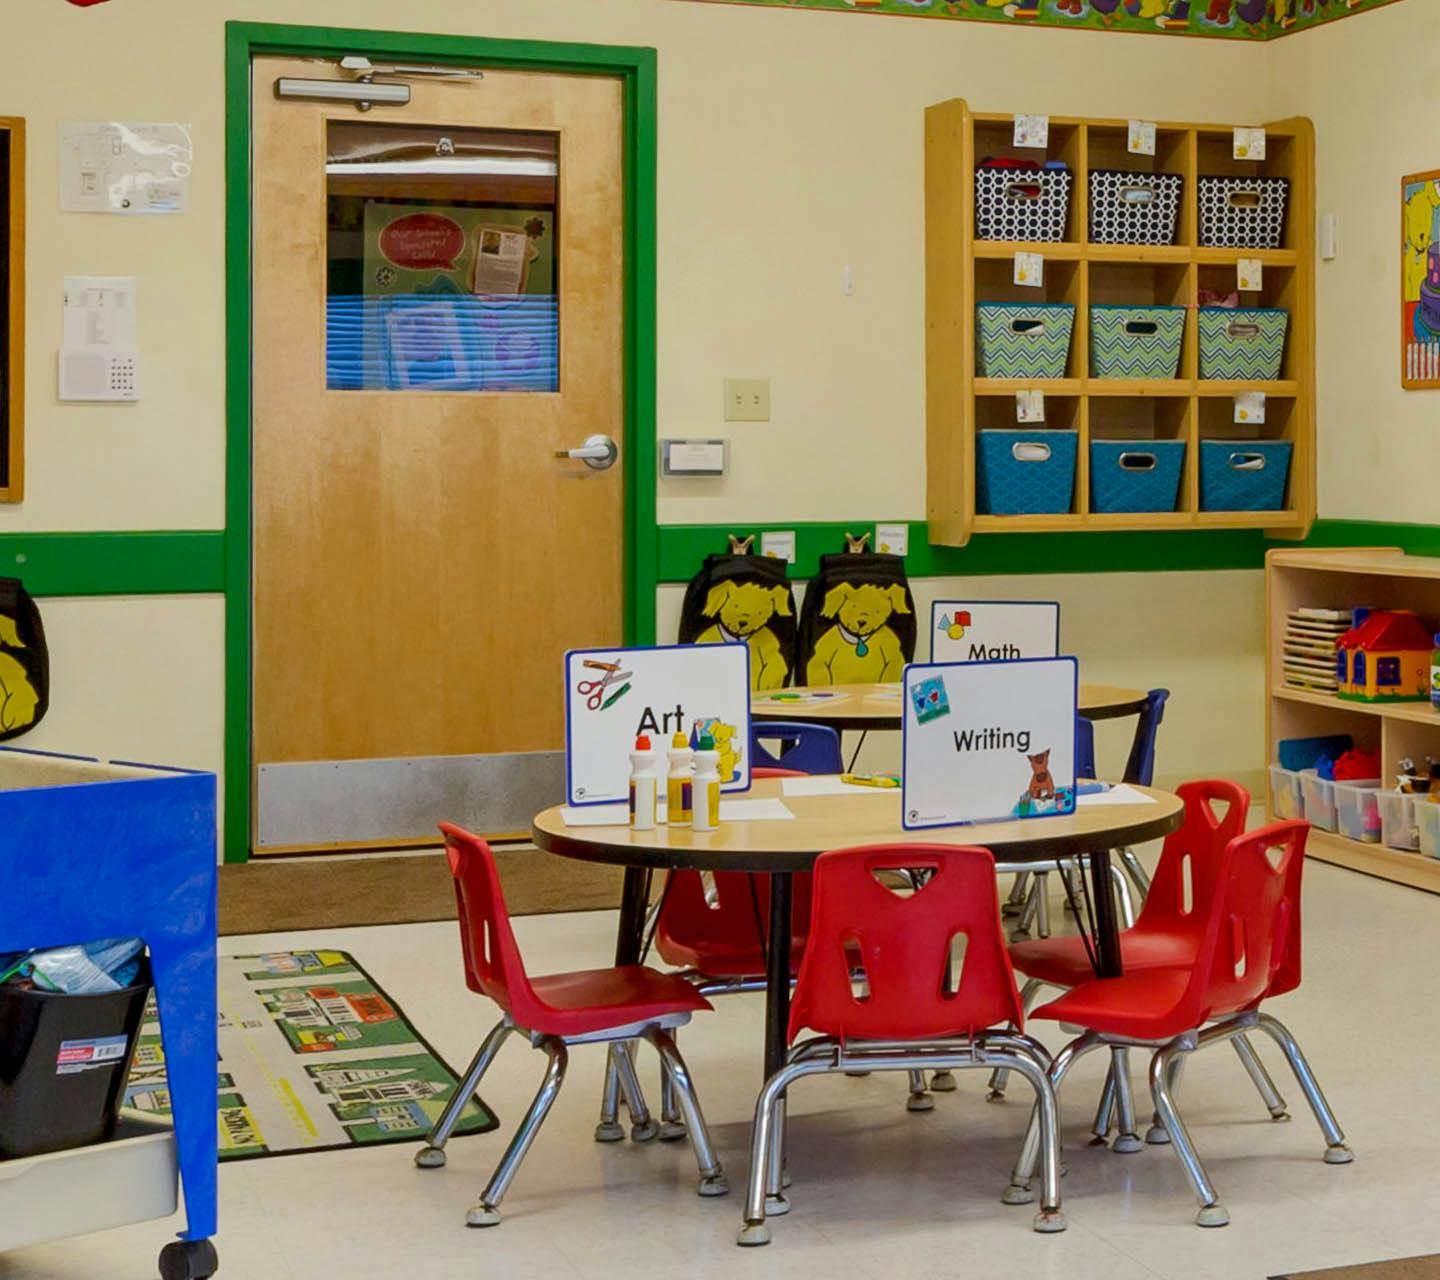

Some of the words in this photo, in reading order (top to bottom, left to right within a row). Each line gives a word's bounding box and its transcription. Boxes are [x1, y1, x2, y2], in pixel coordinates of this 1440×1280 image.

[968, 644, 1021, 660] Math
[636, 704, 685, 736] Art
[954, 727, 1031, 753] Writing
